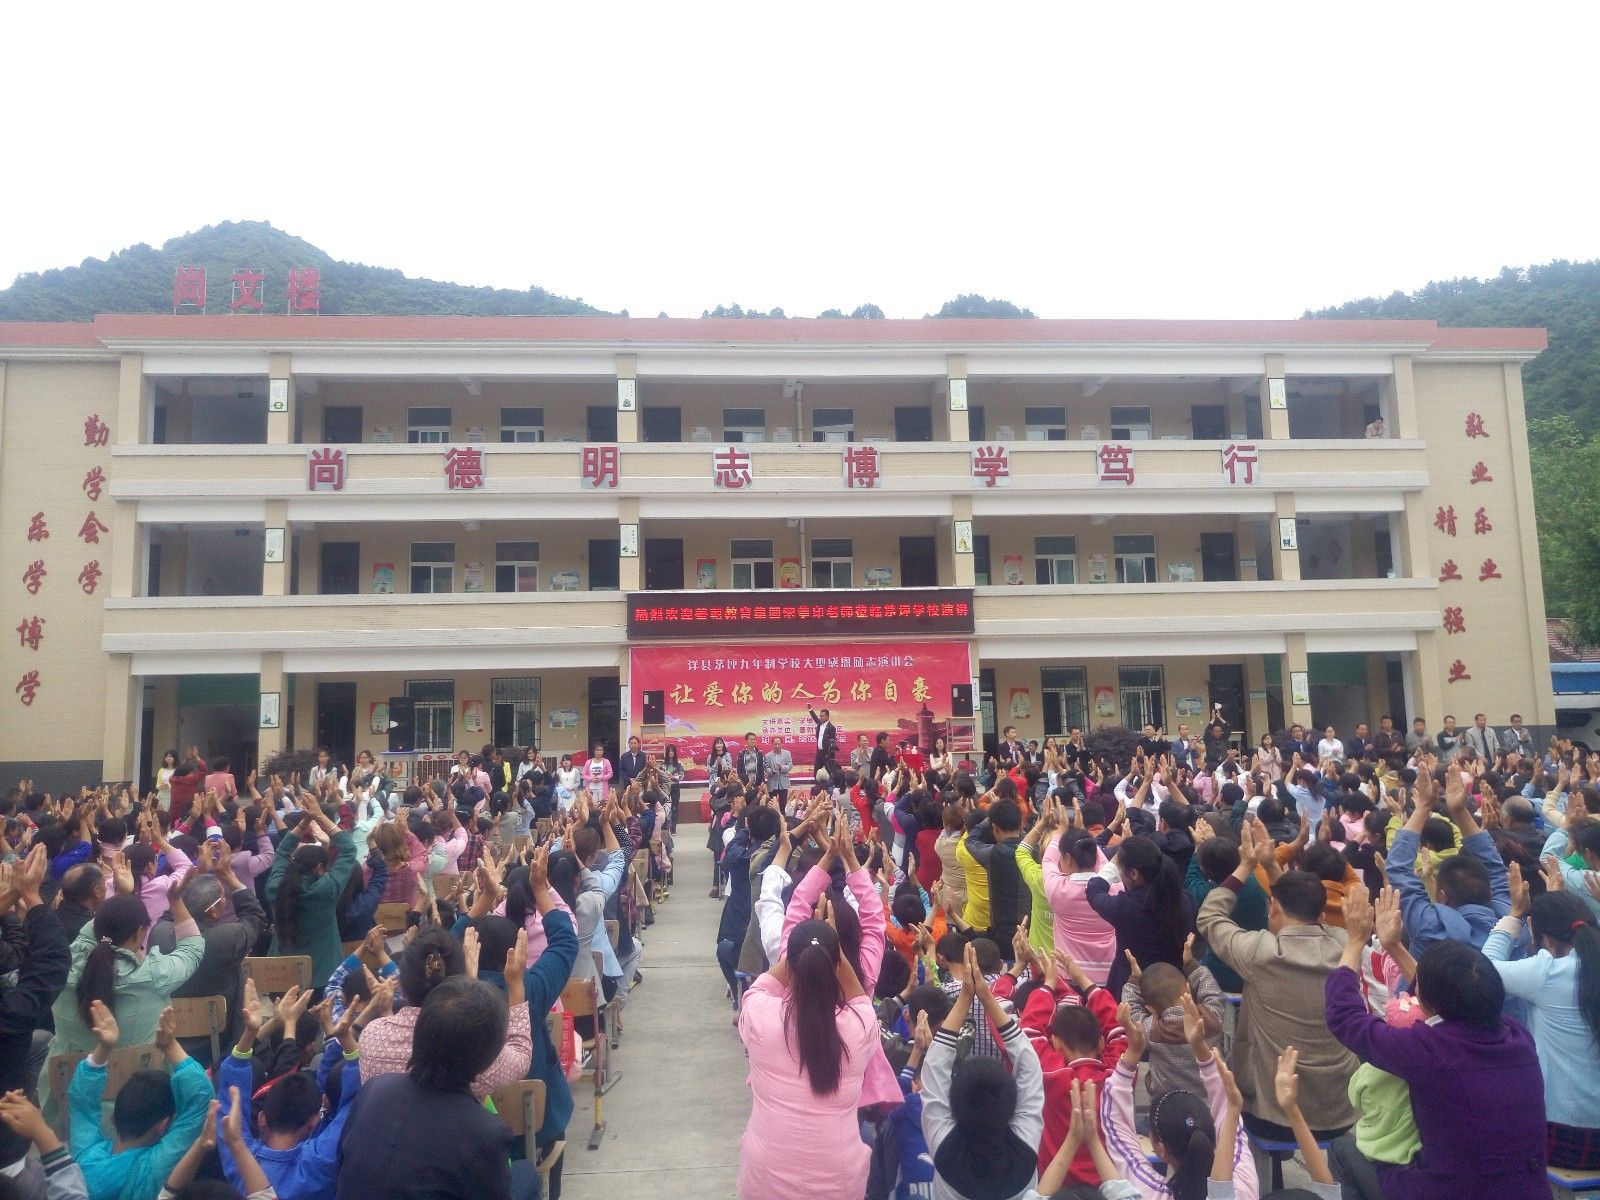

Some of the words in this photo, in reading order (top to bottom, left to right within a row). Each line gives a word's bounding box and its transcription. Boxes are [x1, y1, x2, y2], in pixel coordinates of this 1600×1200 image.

[172, 263, 321, 310] 尚文楼
[77, 413, 110, 595] 勤学会学
[308, 444, 1259, 491] 尚德明志博学笃行
[1464, 411, 1502, 582] 敬业乐业
[15, 511, 50, 707] 乐学博学
[1433, 505, 1471, 684] 精业强业
[669, 676, 935, 708] 让爱你的人为你自豪
